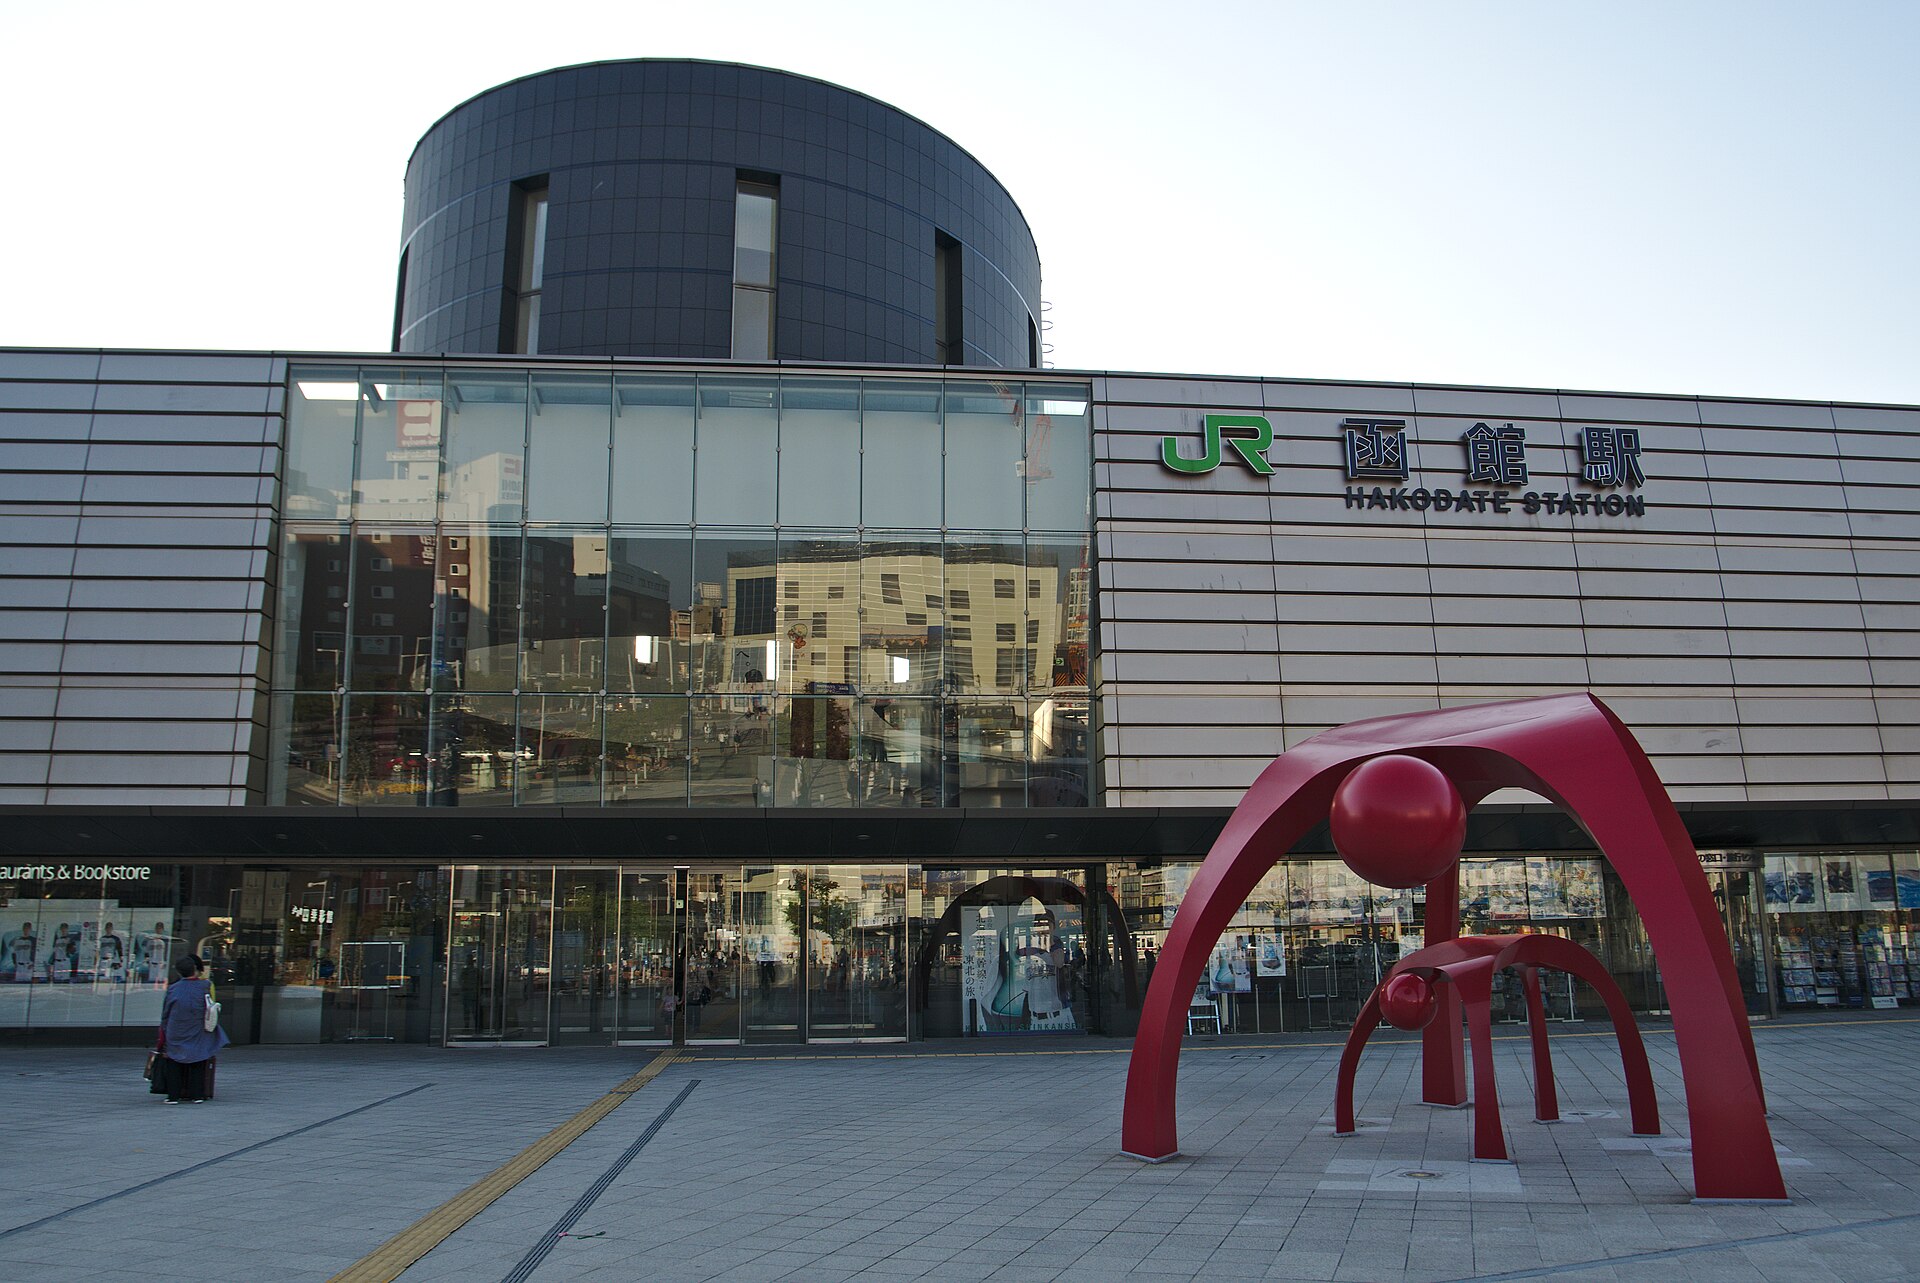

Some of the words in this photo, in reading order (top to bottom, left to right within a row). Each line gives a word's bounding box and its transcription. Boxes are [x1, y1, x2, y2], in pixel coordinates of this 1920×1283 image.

[1161, 413, 1276, 476] JR
[1343, 417, 1646, 488] 函館駅
[1345, 485, 1512, 513] HAKODATE
[1523, 490, 1646, 516] STATION
[57, 865, 71, 880] &
[74, 864, 151, 881] Bookstore
[963, 955, 975, 997] 東北の旅
